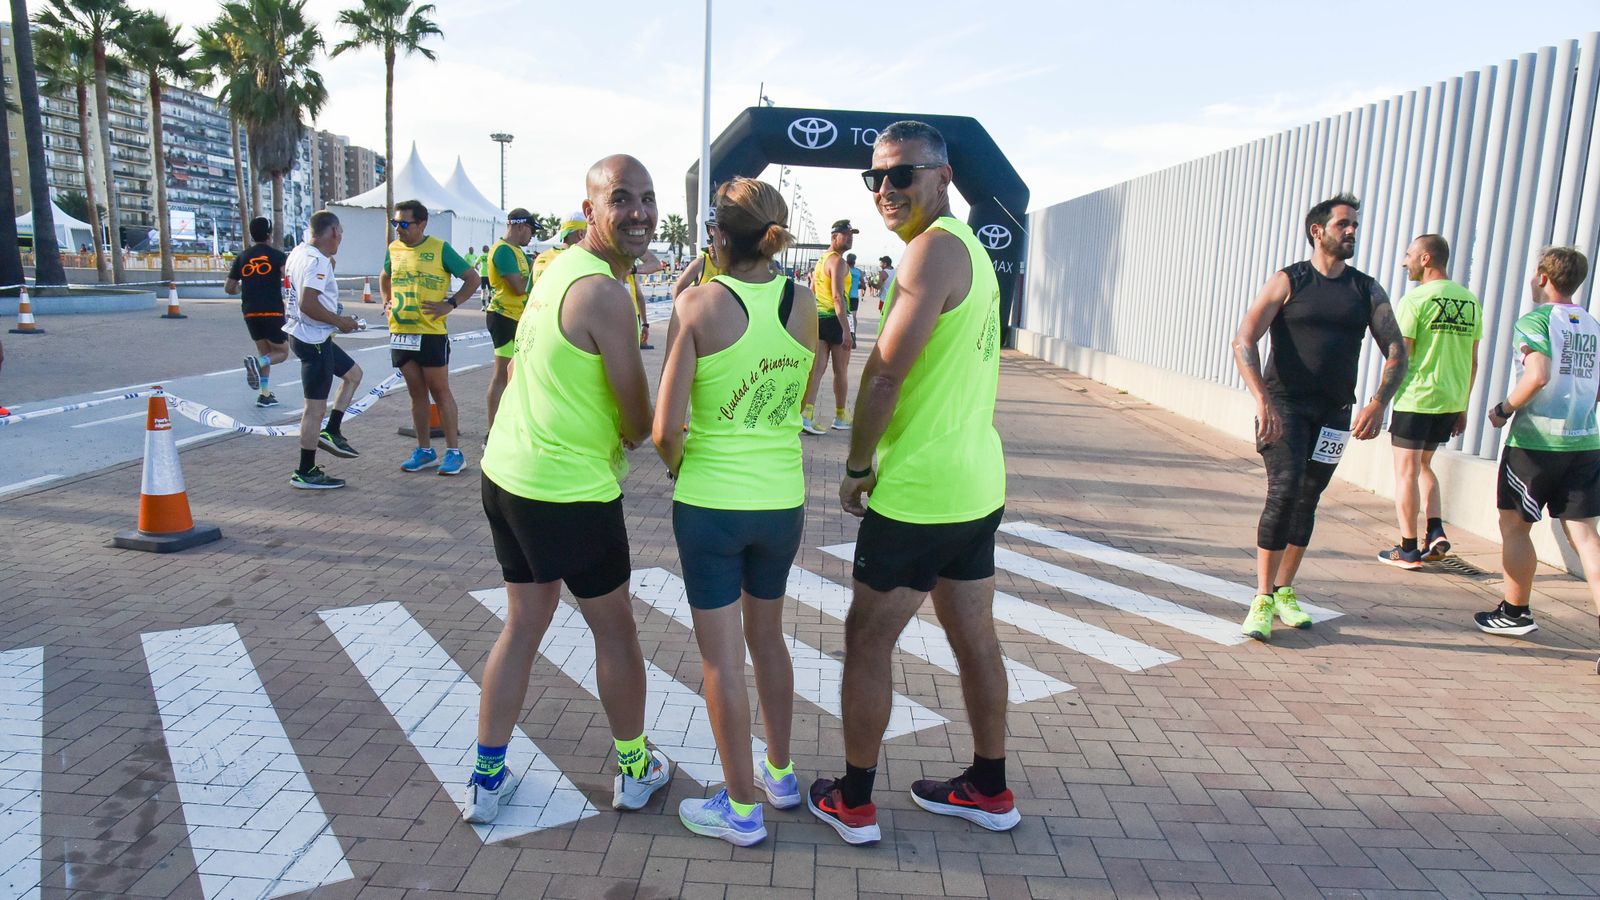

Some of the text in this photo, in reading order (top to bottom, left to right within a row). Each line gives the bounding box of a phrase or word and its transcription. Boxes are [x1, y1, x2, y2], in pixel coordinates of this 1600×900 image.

[850, 127, 880, 146] TO
[1431, 297, 1475, 326] XXI
[750, 371, 759, 385] de
[1318, 440, 1344, 455] 238
